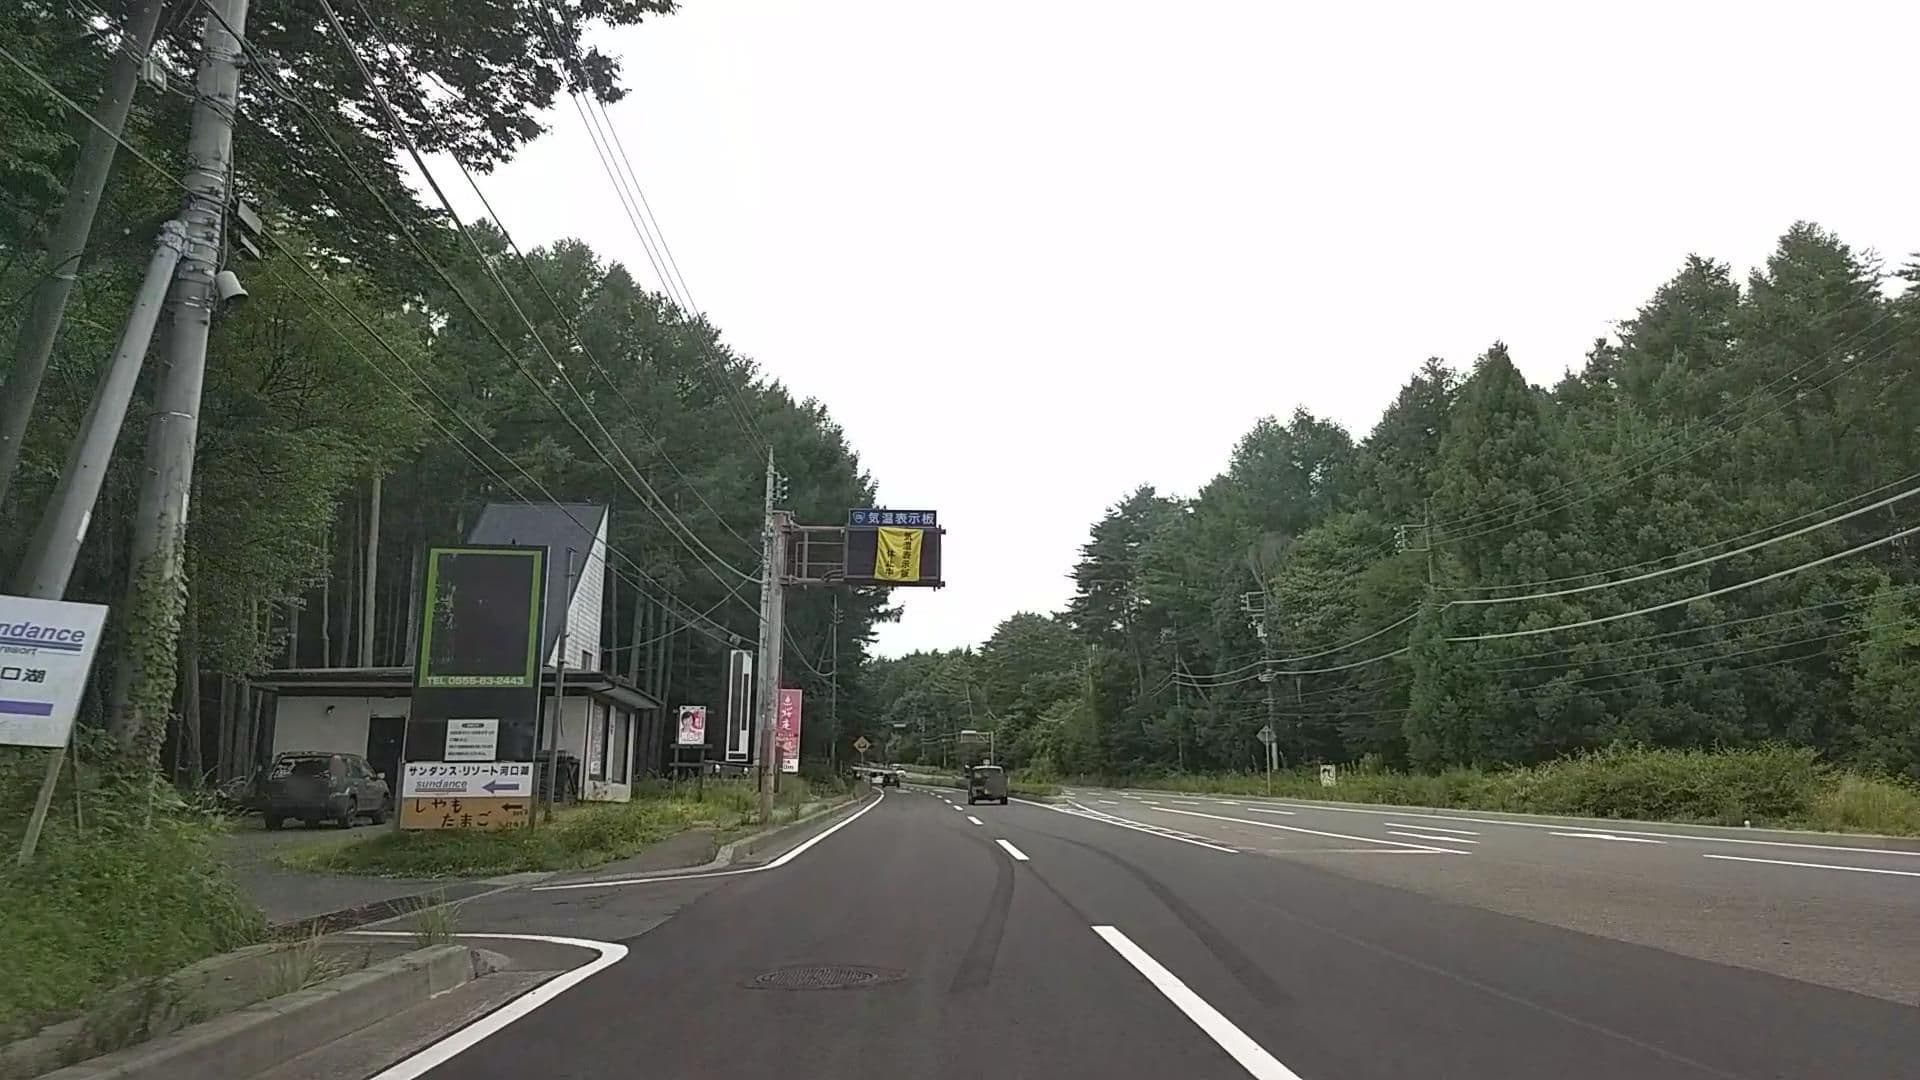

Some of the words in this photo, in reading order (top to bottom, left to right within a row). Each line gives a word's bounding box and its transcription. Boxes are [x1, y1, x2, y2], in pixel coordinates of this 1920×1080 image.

[868, 512, 935, 525] 気温表示板
[427, 676, 446, 685] TEL
[416, 779, 468, 788] sundance
[441, 810, 492, 828] たまご
